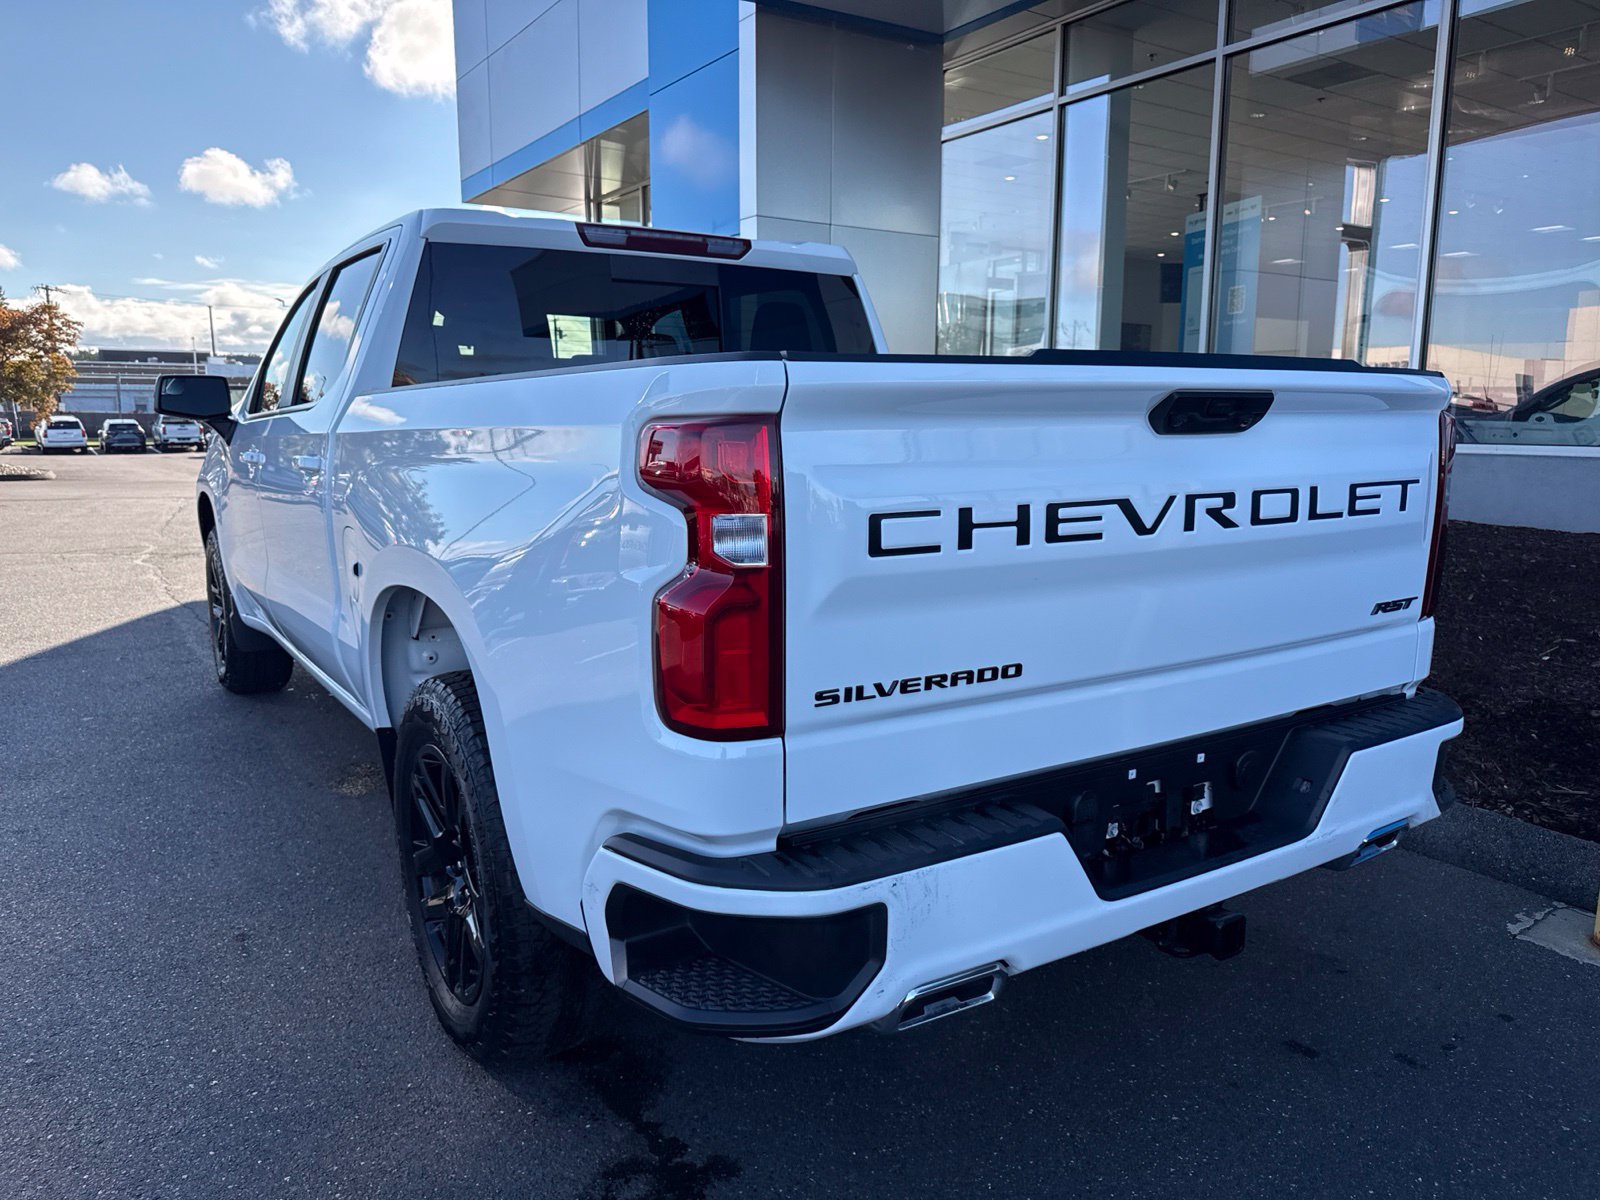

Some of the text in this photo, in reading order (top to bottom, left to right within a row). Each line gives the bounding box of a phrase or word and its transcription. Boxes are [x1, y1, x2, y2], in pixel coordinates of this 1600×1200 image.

[868, 479, 1420, 557] CHEVROLET
[1370, 596, 1419, 616] RST
[814, 662, 1023, 707] SILVERADO
